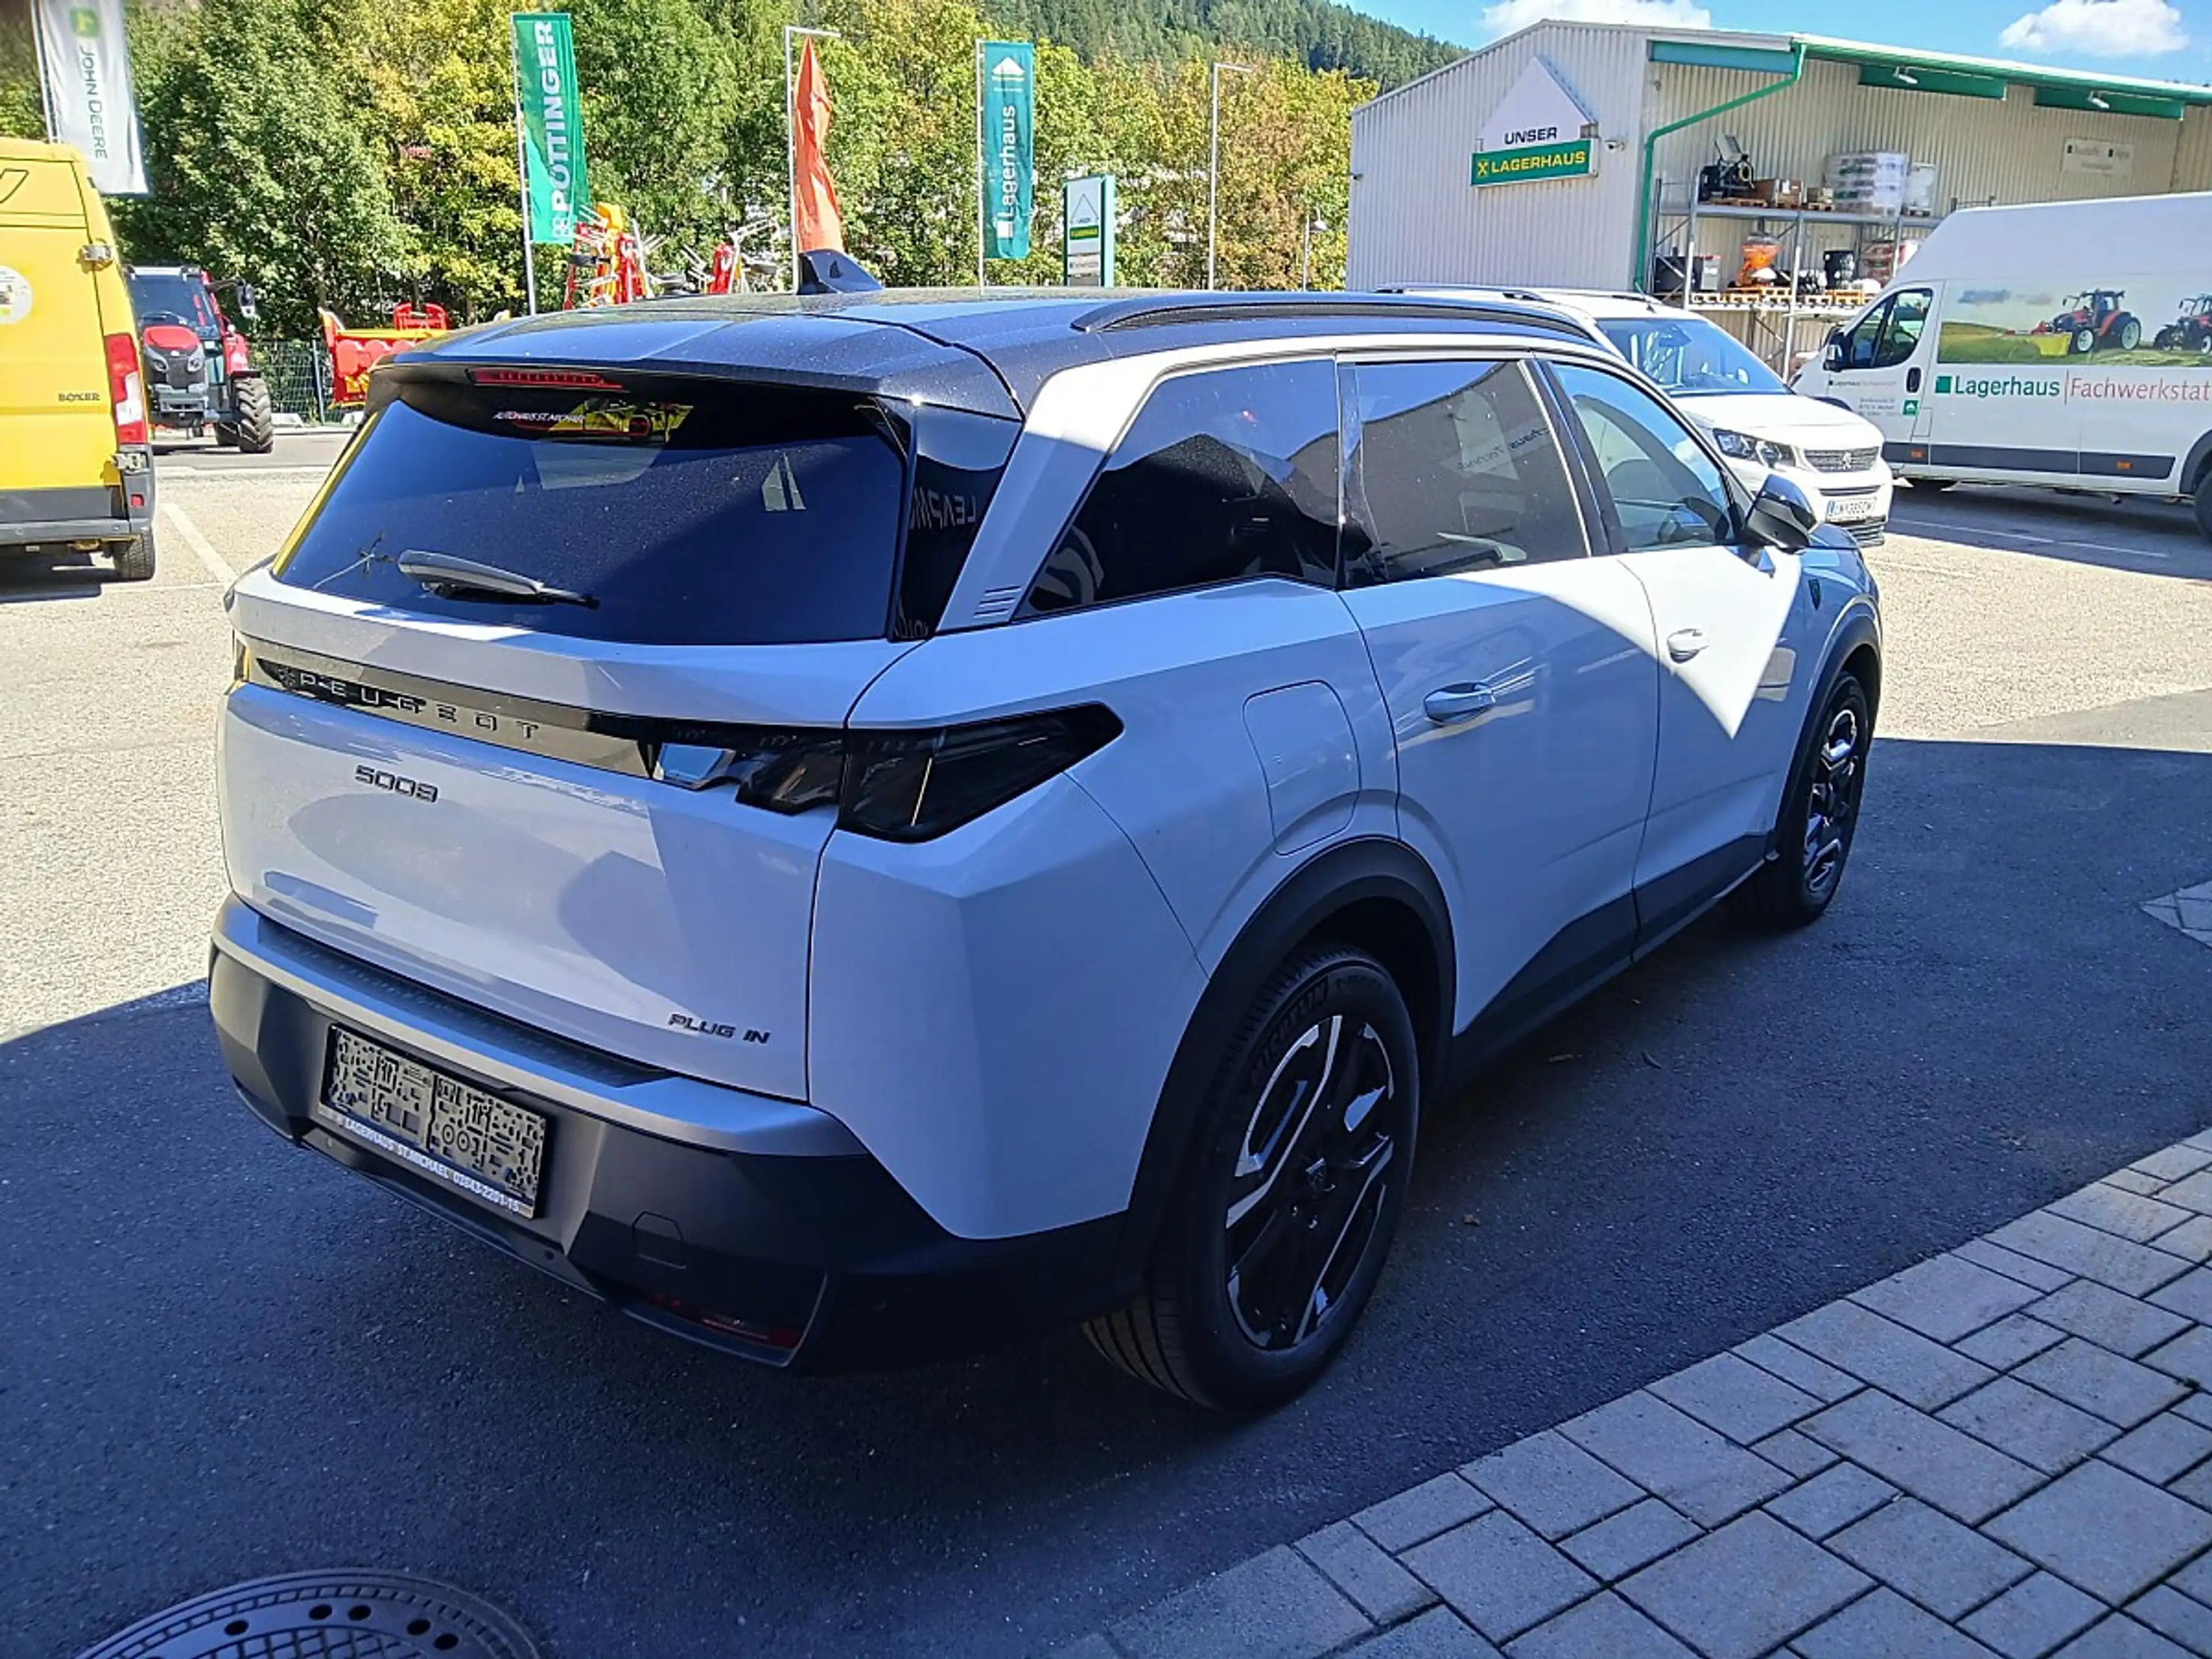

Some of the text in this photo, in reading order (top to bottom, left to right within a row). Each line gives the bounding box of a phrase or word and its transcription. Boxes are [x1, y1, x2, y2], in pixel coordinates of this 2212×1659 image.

[79, 45, 108, 160] JOHN DEERE
[1504, 127, 1557, 145] UNSER
[997, 105, 1018, 219] Lagerhaus
[1491, 151, 1586, 173] LAGERHAUS
[58, 392, 101, 402] BOXER
[1955, 376, 2211, 401] Lagerhaus Fachwerkstat
[299, 672, 539, 740] PEUGEOT
[355, 764, 438, 802] 5008
[668, 1013, 771, 1044] PLUG IN
